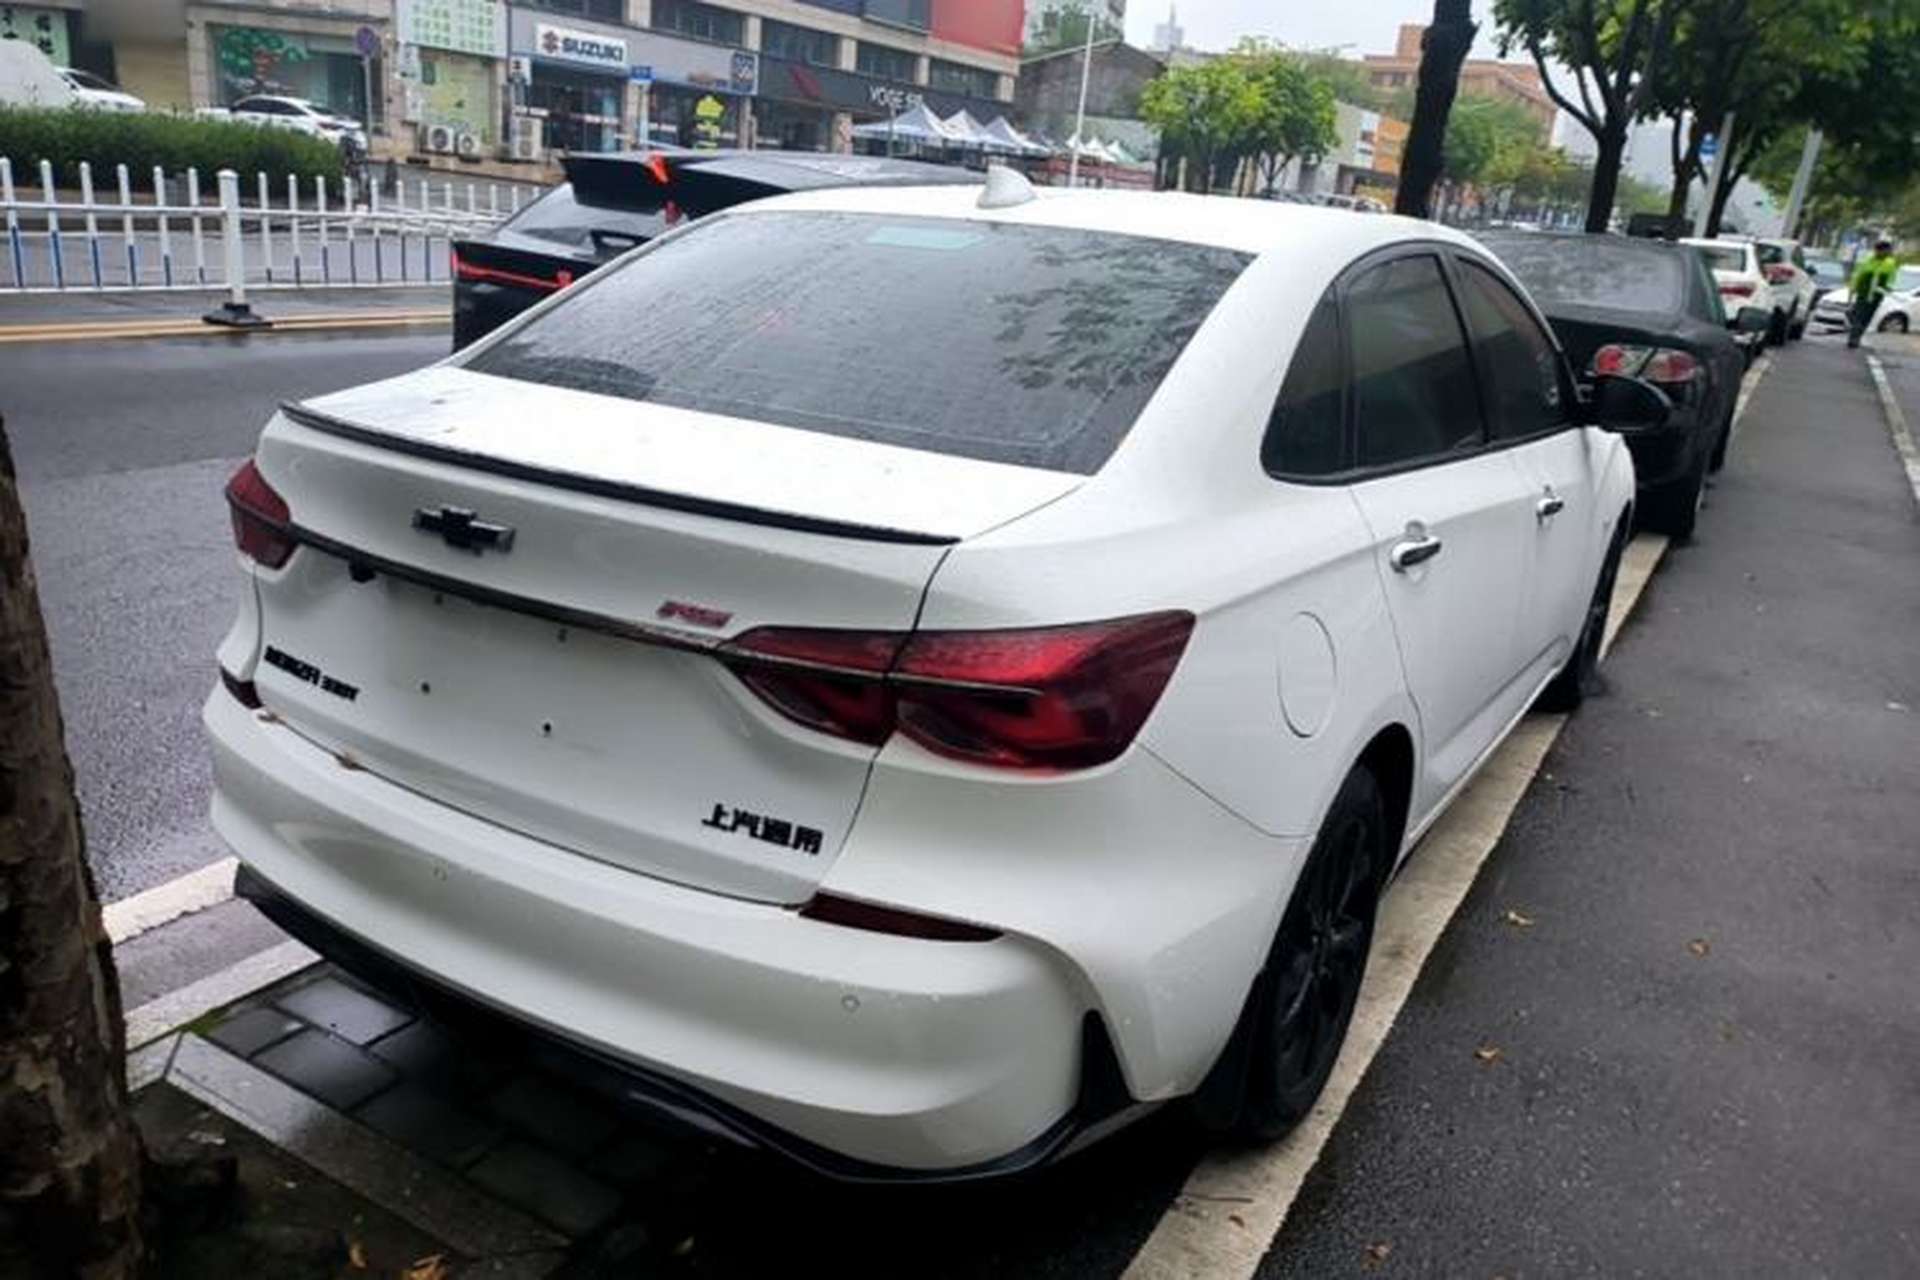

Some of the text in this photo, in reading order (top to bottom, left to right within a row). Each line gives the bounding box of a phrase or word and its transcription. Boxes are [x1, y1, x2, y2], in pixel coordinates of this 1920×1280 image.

[562, 37, 624, 61] SUZUKI
[701, 803, 823, 855] 上汽通用
